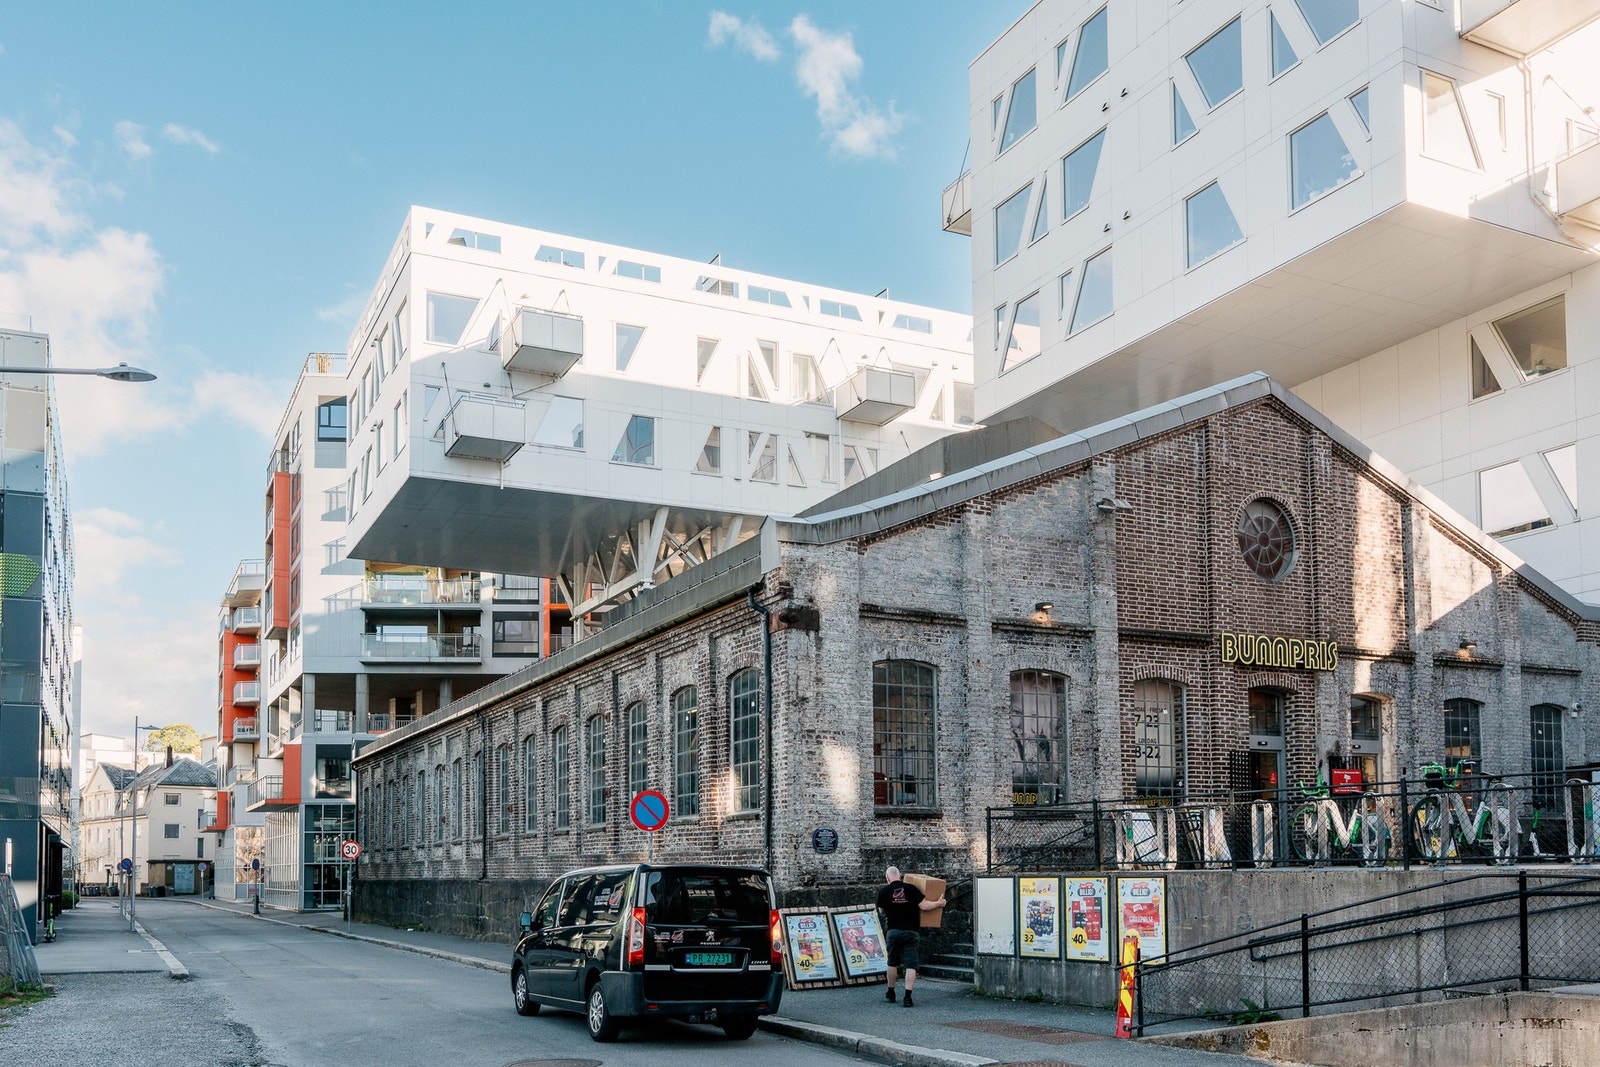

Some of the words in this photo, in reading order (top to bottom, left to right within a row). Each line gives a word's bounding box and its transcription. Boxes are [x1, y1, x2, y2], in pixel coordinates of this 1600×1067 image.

[1221, 632, 1338, 671] BUNNPRIS
[345, 845, 357, 855] 30
[692, 954, 704, 962] PR
[706, 954, 730, 963] 27231
